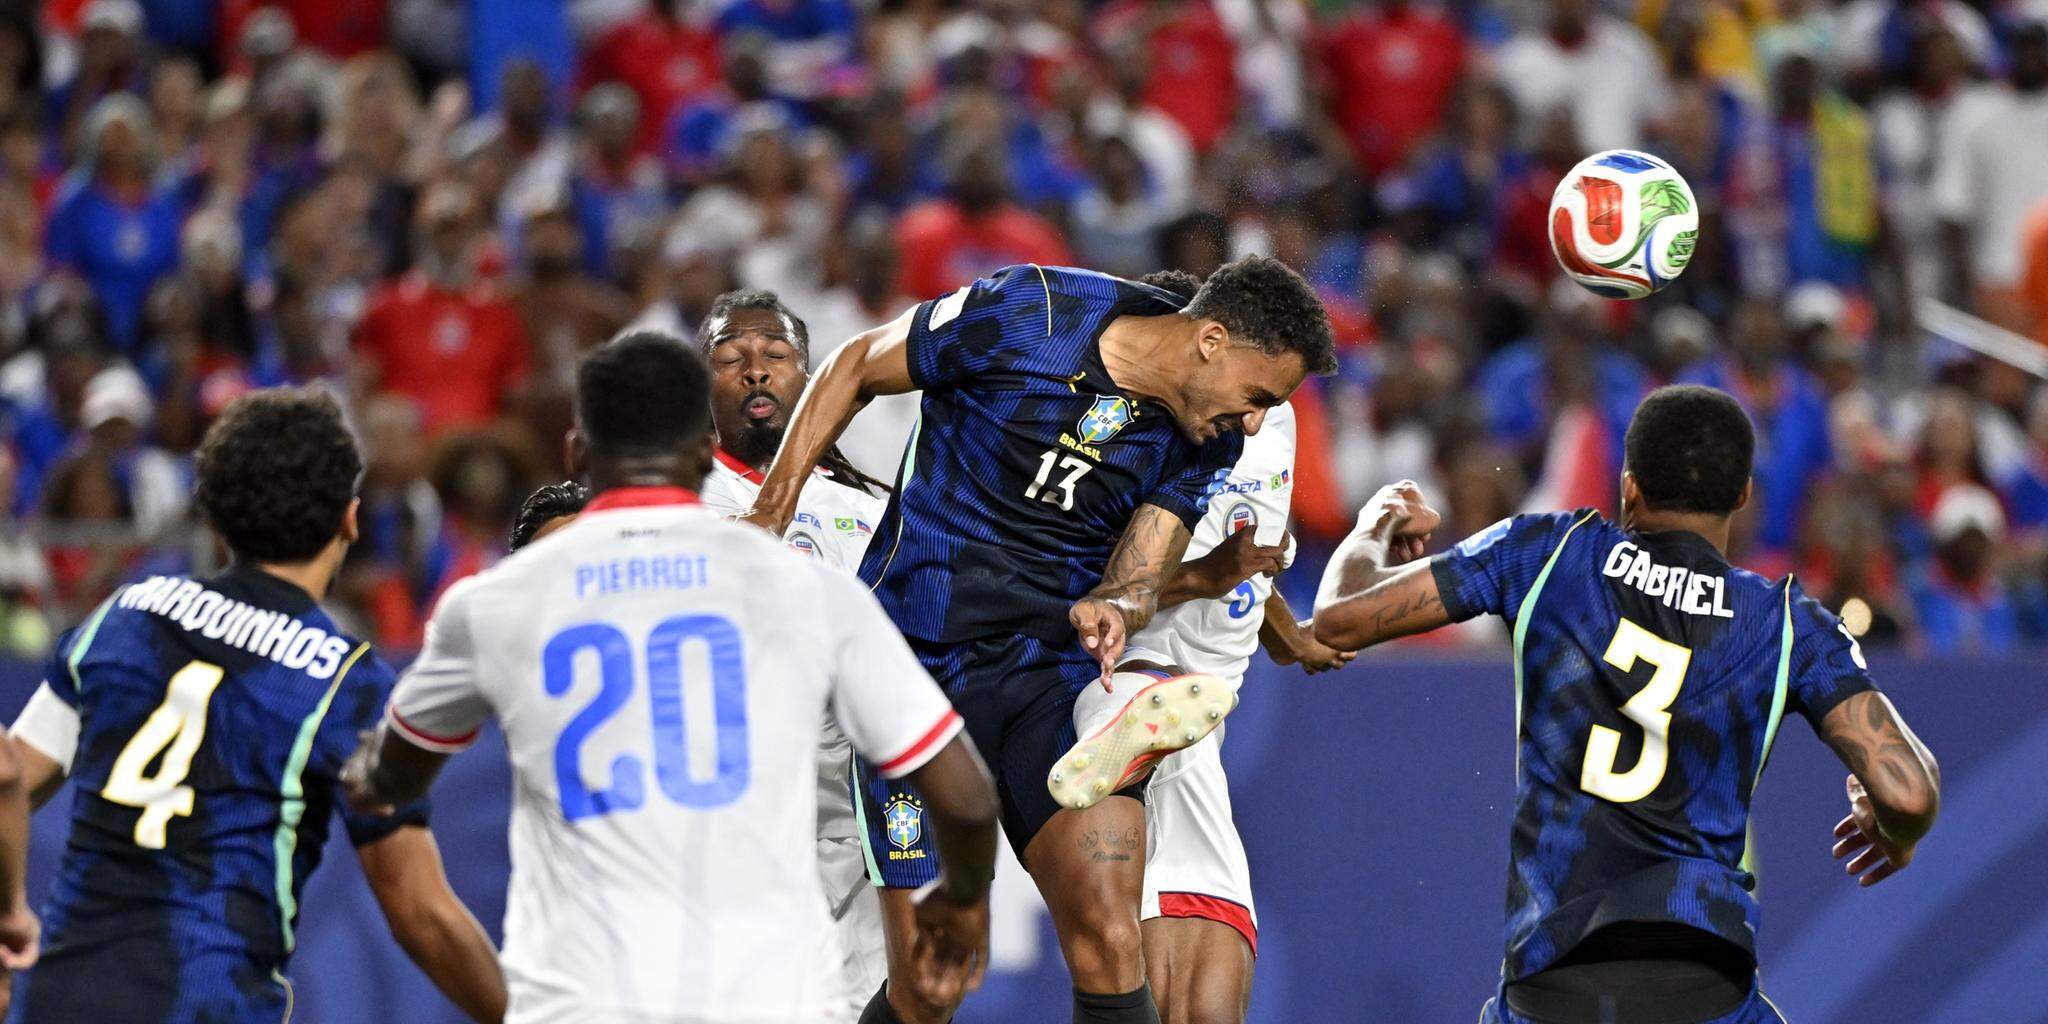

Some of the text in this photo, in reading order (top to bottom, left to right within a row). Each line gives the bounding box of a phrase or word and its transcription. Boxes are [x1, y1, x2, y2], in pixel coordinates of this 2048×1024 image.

[1059, 432, 1102, 463] BRASIL
[1097, 414, 1113, 426] CBF
[1024, 447, 1093, 512] 13
[794, 512, 822, 531] ETA
[576, 553, 708, 599] PIERROT
[1602, 540, 1734, 618] GABRIEL
[118, 575, 350, 680] MARQUINHOS
[543, 614, 752, 823] 20
[1580, 617, 1693, 803] 3
[101, 660, 224, 849] 4
[896, 820, 909, 828] CBF
[888, 849, 927, 861] BRASIL
